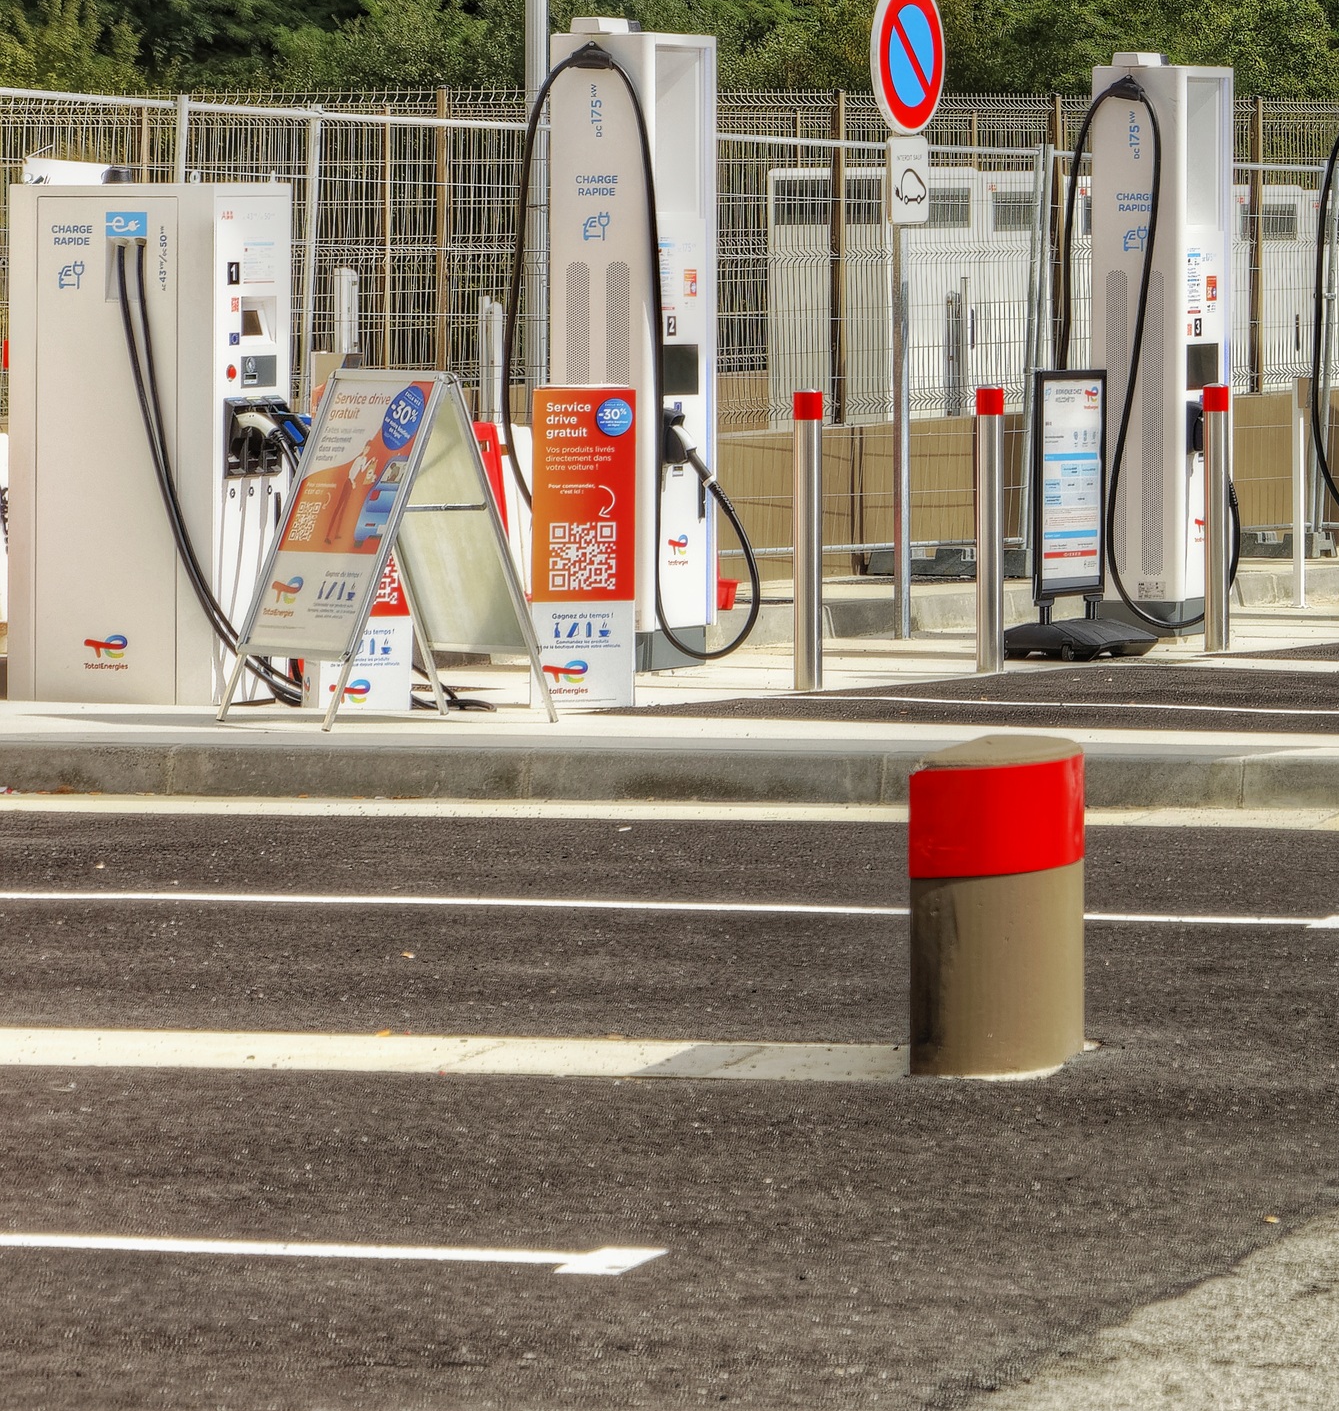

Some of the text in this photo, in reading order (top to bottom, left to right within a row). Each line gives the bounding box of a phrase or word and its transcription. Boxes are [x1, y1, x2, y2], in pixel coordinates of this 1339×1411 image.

[591, 99, 602, 124] 175
[1129, 125, 1140, 147] 175
[576, 175, 618, 184] CHARGE
[578, 188, 615, 196] RAPIDE
[51, 225, 93, 234] CHARGE
[53, 236, 90, 246] RAPIDE
[335, 392, 391, 405] Service drive
[546, 402, 591, 412] Service
[329, 407, 360, 421] gratuit
[391, 400, 419, 425] -30%
[598, 408, 627, 420] -30%
[546, 414, 577, 425] drive
[546, 427, 587, 439] gratuit
[562, 446, 593, 454] produits
[589, 612, 610, 620] temps
[84, 663, 128, 671] TotalEnergies
[549, 687, 588, 695] talEnergies
